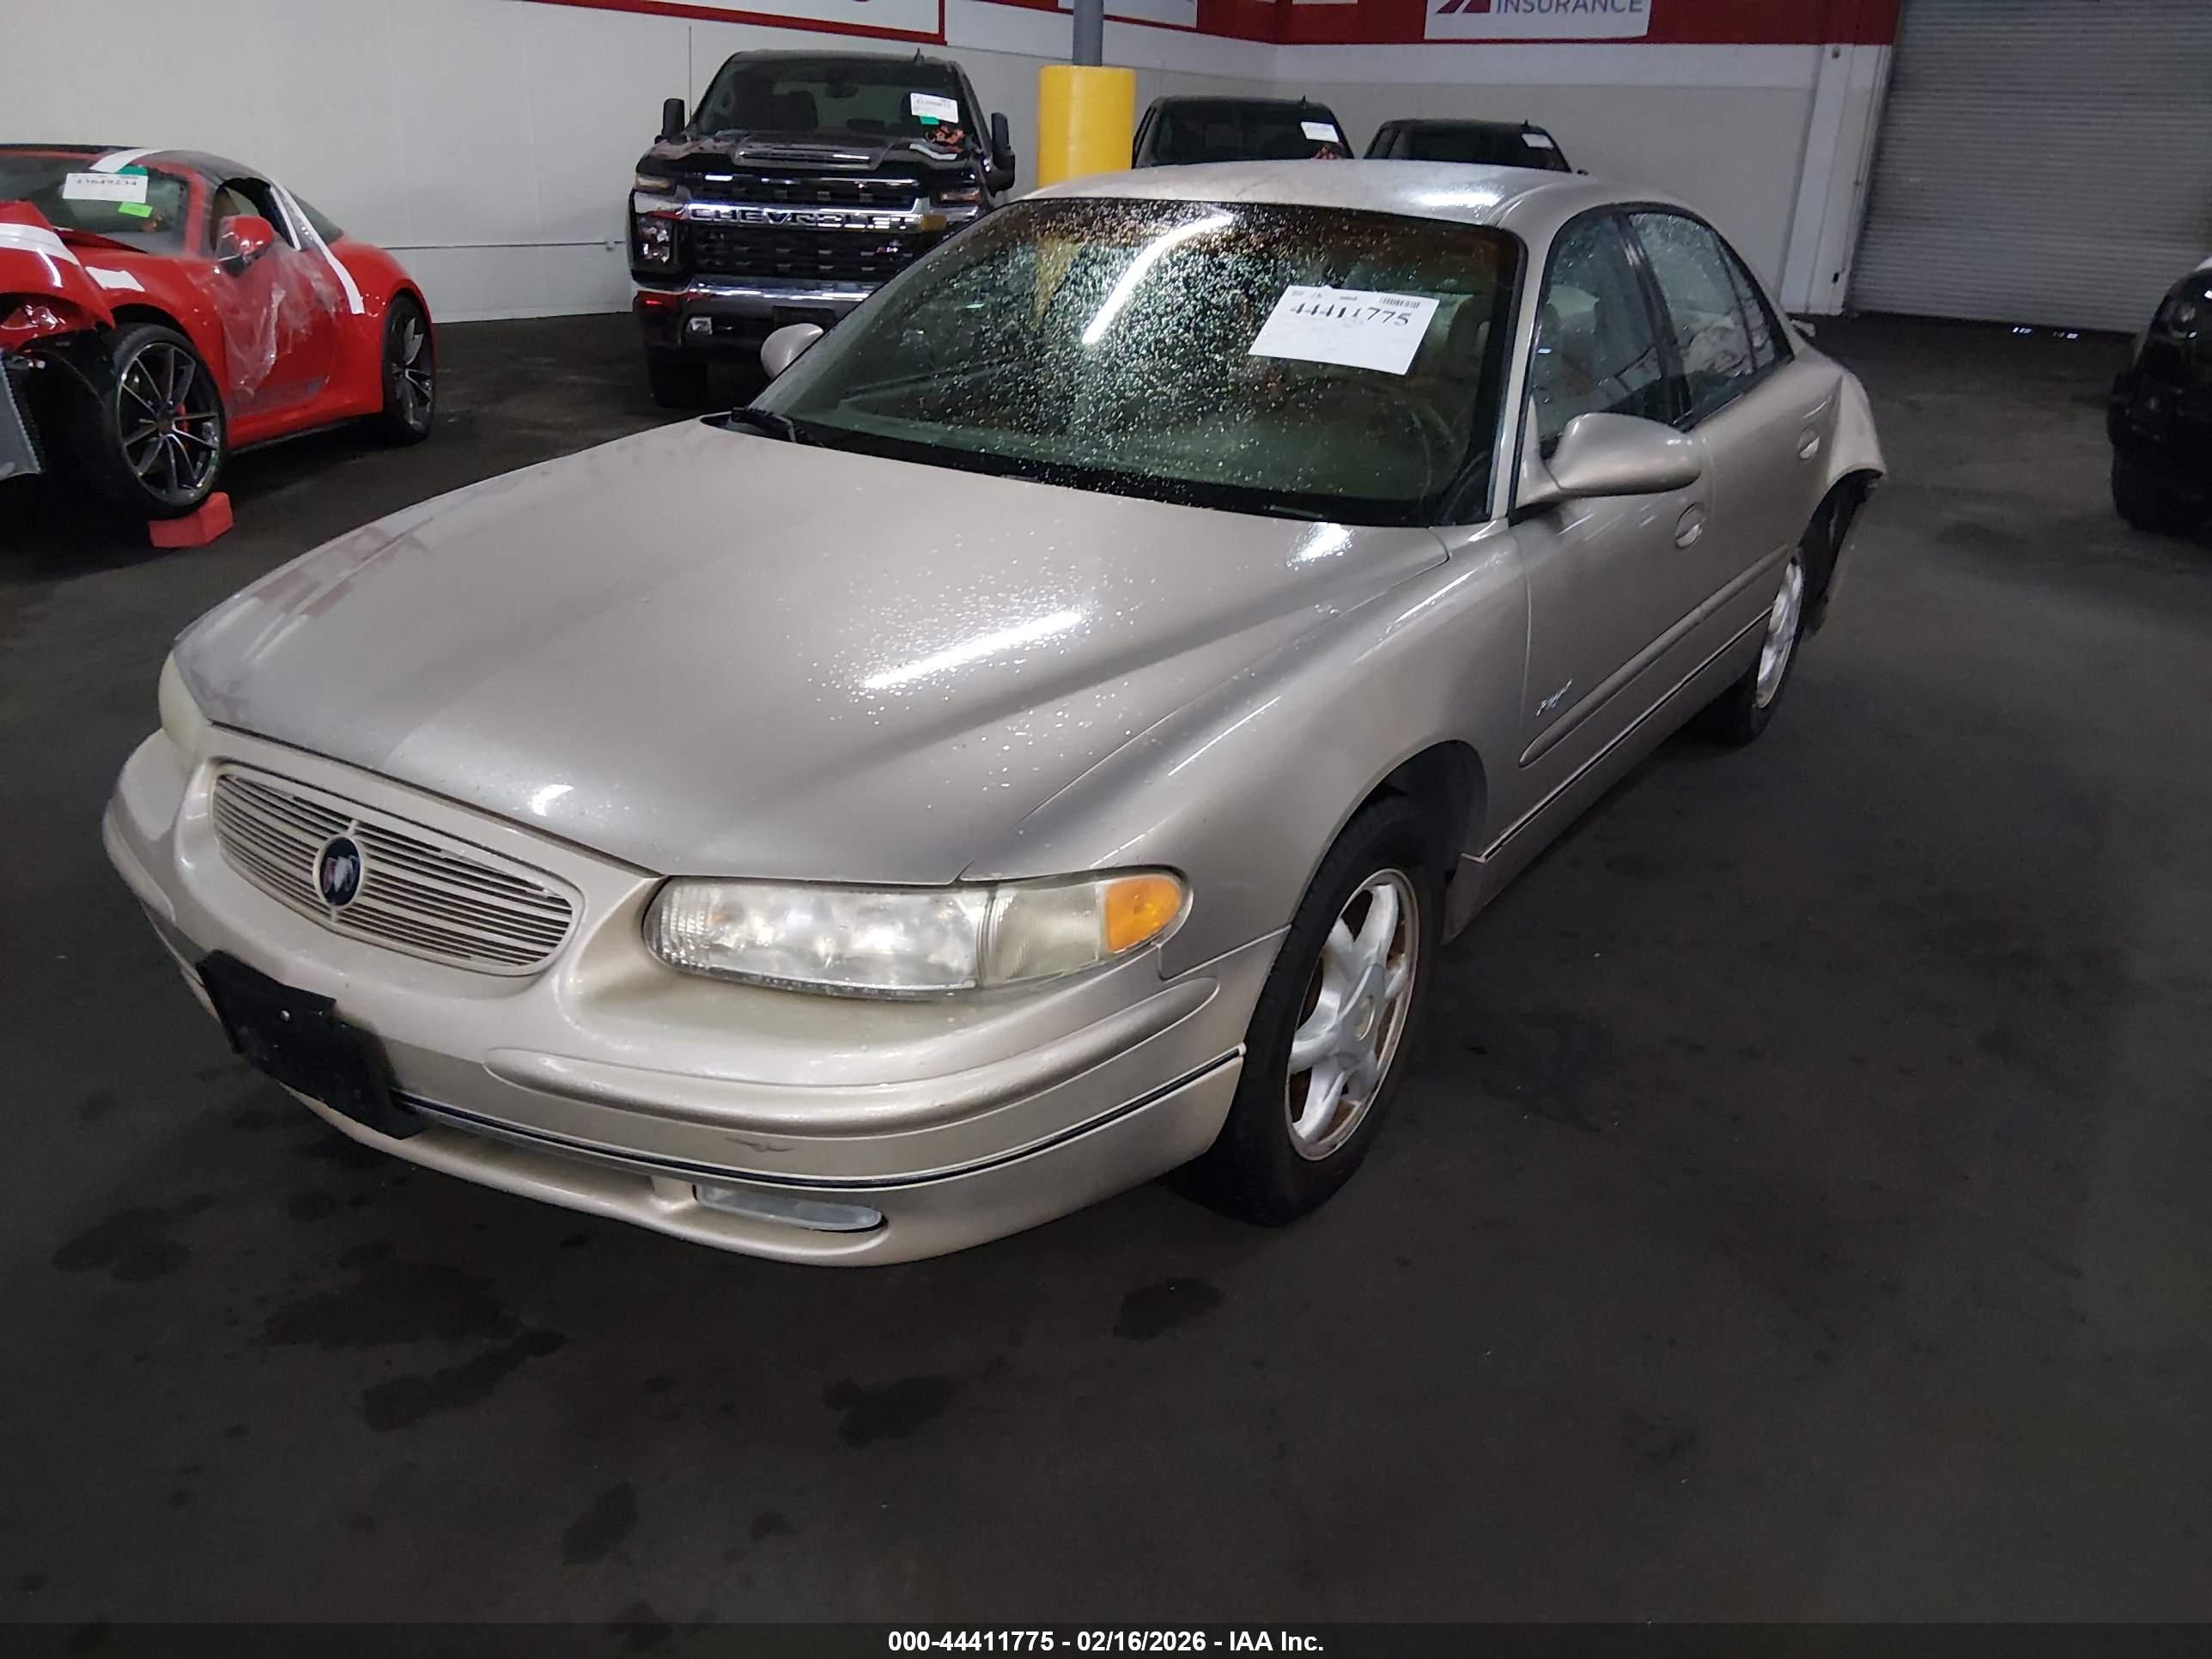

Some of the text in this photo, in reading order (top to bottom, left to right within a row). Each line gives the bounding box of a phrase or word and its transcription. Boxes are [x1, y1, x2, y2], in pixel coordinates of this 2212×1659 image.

[1496, 0, 1643, 15] INSURANCE
[690, 208, 917, 230] CHEVROLET
[1290, 302, 1413, 326] 44411775
